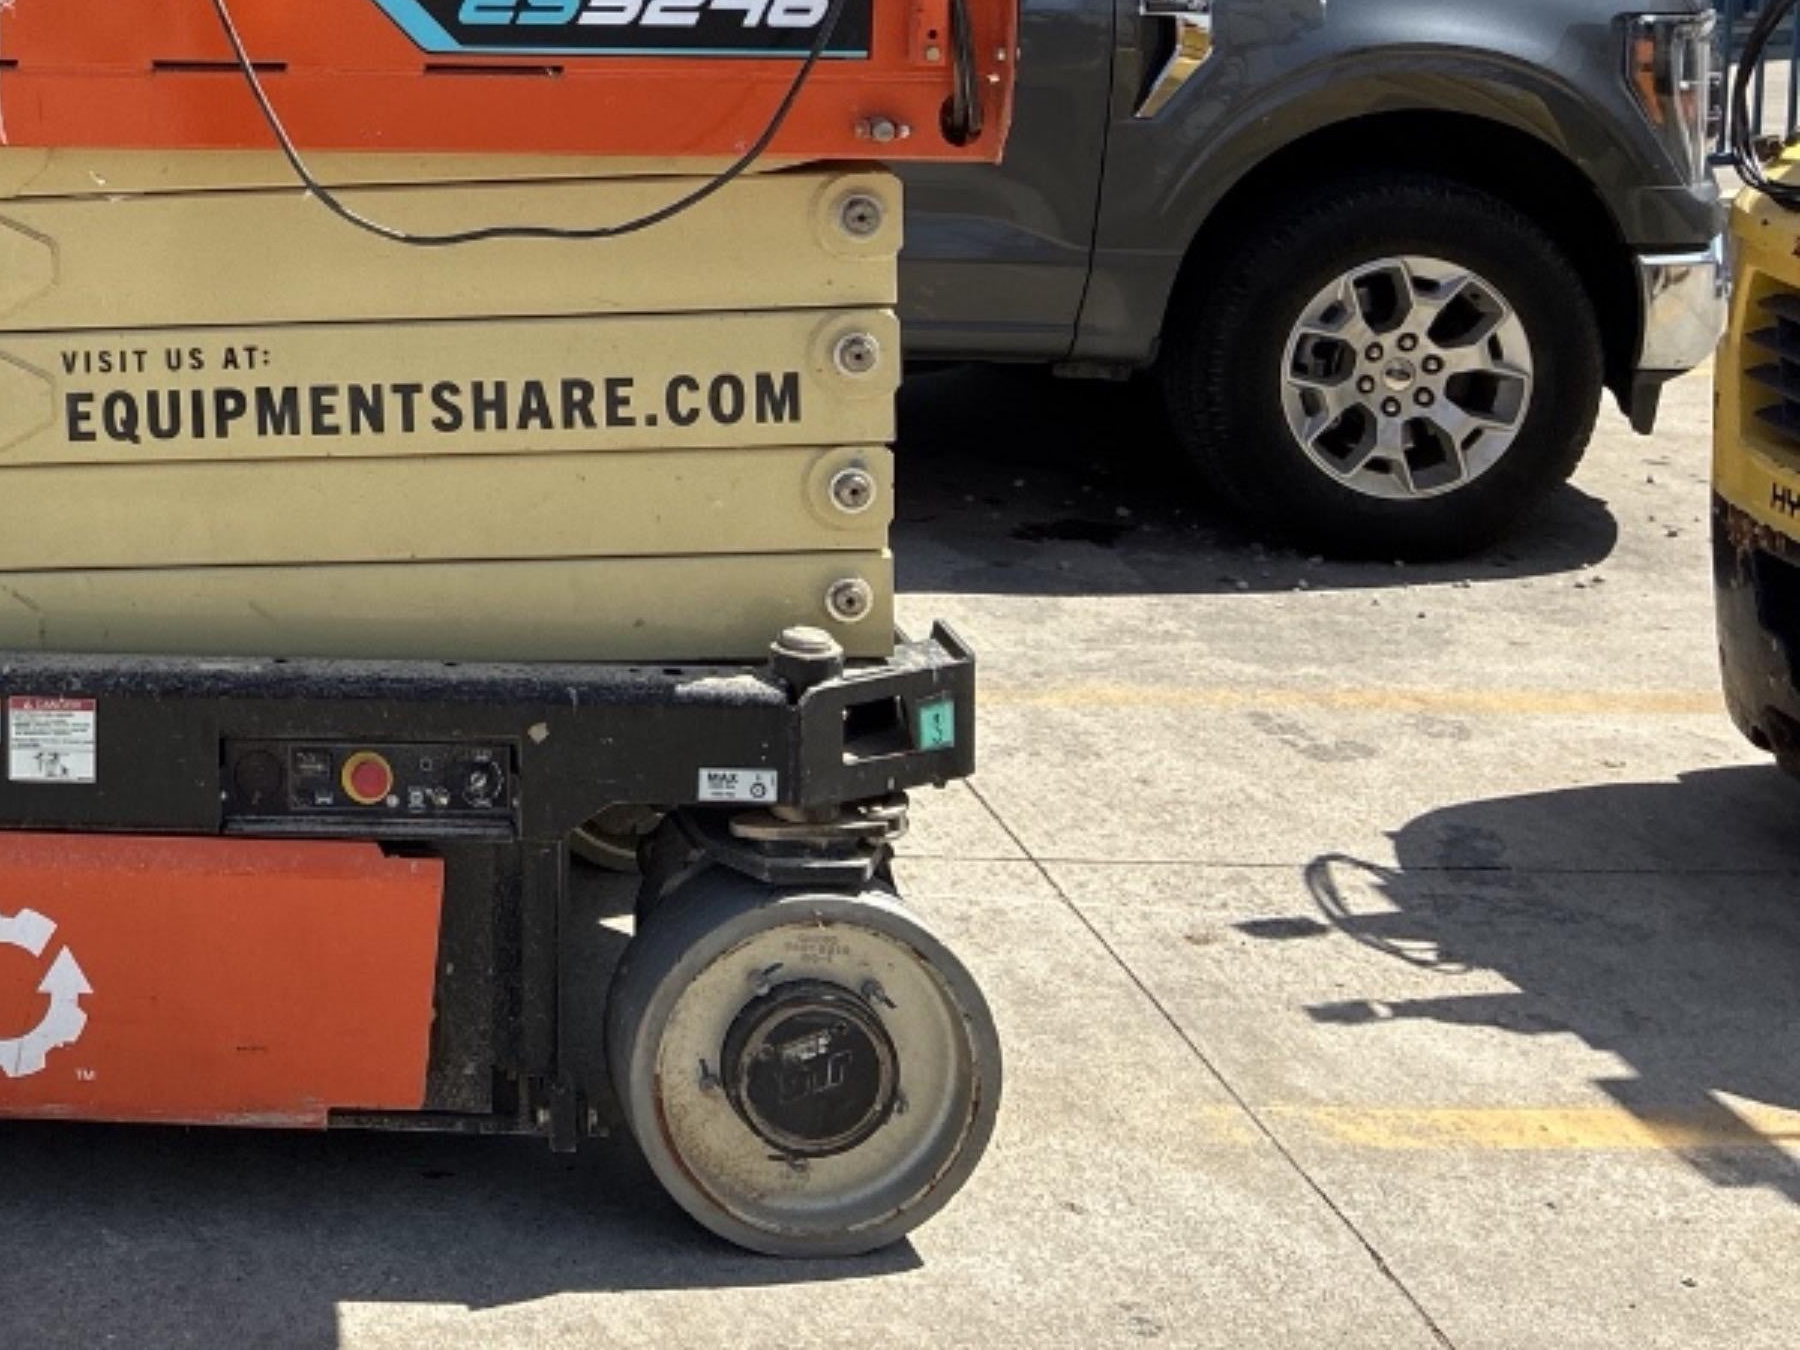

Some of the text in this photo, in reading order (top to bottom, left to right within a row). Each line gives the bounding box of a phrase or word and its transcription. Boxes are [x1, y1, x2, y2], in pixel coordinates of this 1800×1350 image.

[62, 346, 272, 374] VISIT US AT:
[65, 371, 802, 443] EQUIPMENTSHARE.COM
